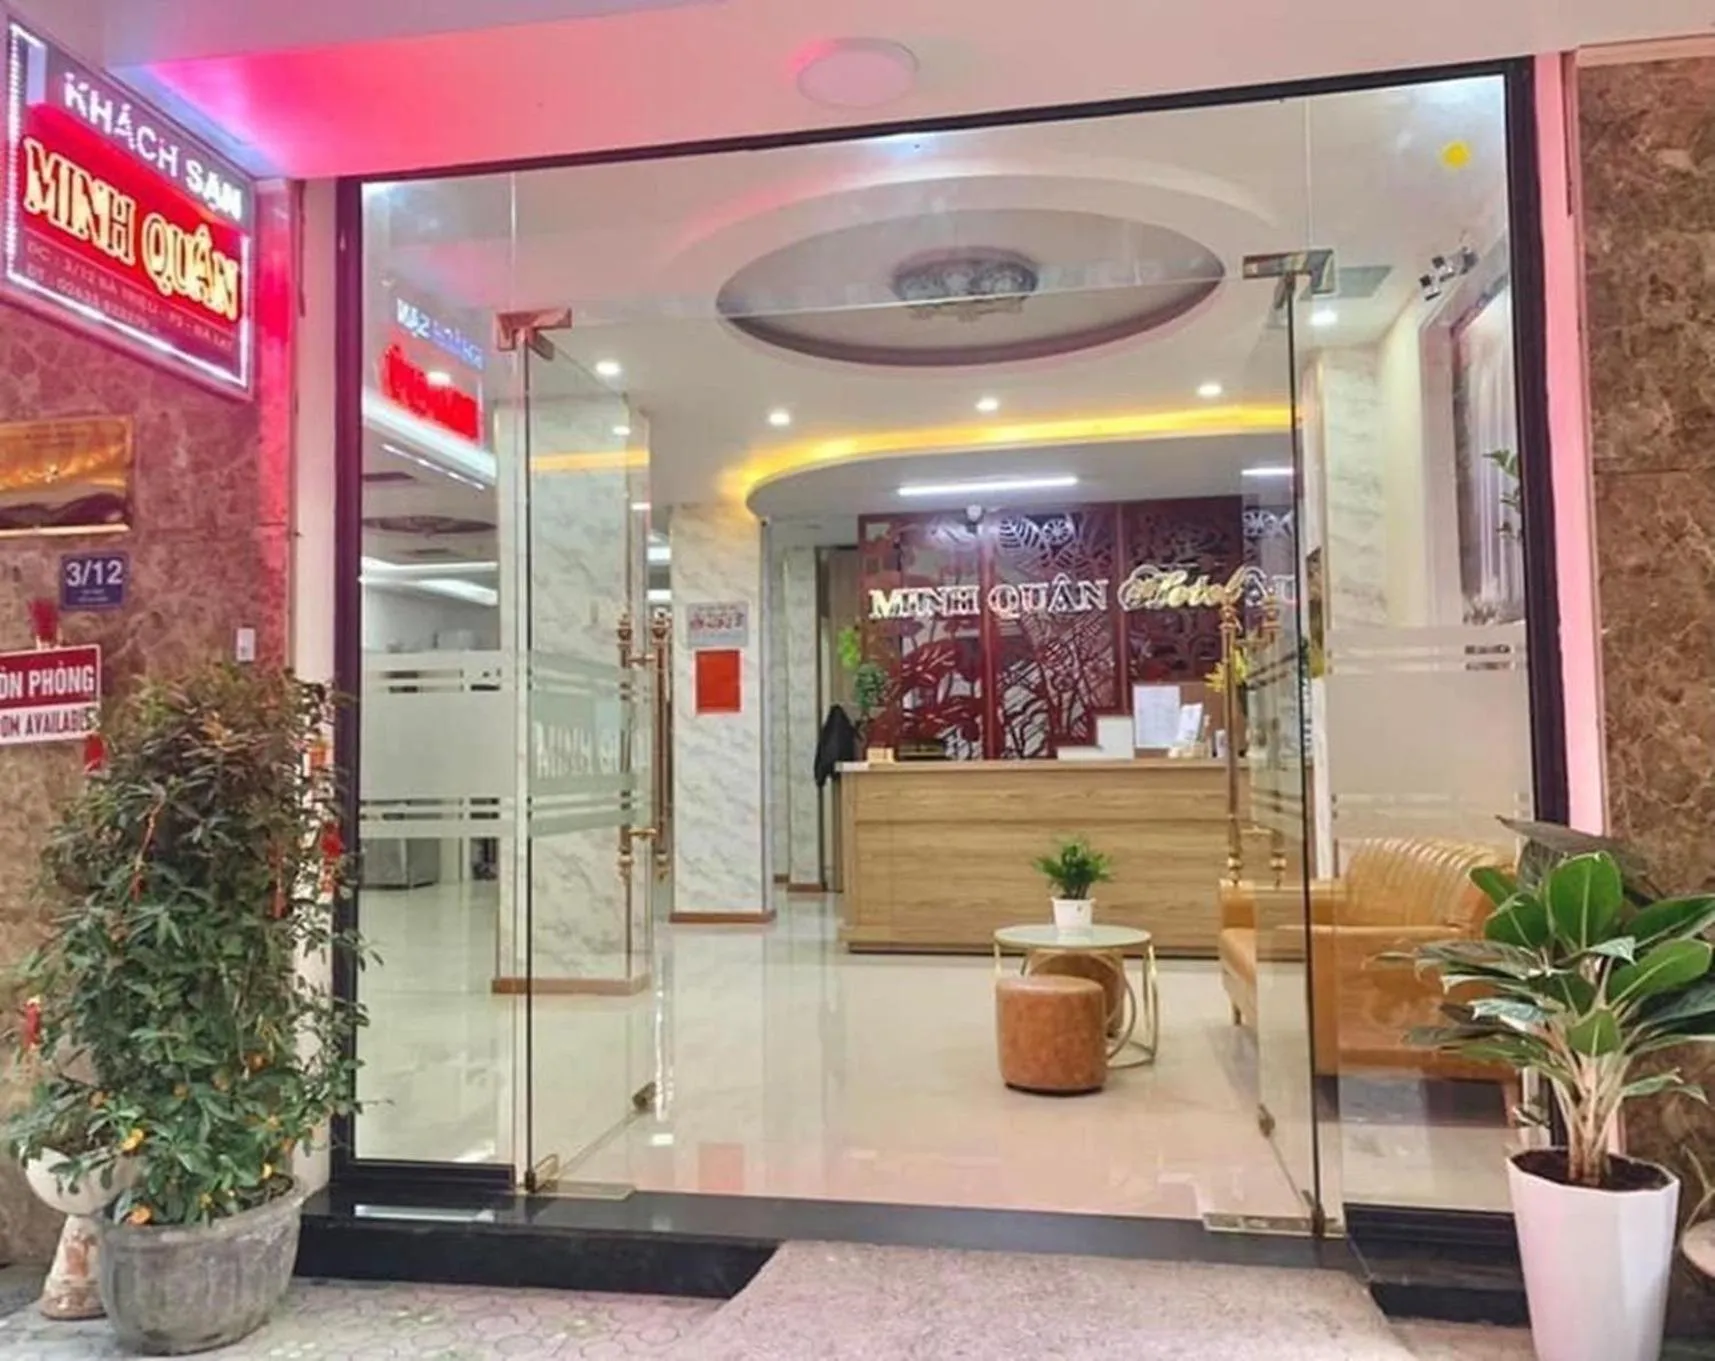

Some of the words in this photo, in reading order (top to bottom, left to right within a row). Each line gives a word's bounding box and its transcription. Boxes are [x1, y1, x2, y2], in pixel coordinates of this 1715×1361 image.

[64, 71, 179, 177] KHÁCH
[185, 160, 242, 221] SẠN
[23, 137, 135, 266] MINH
[143, 213, 238, 320] QUÂN
[66, 560, 123, 587] 3/12
[868, 585, 980, 620] MINH
[987, 571, 1109, 620] QUÂN
[28, 660, 95, 698] PHÒNG
